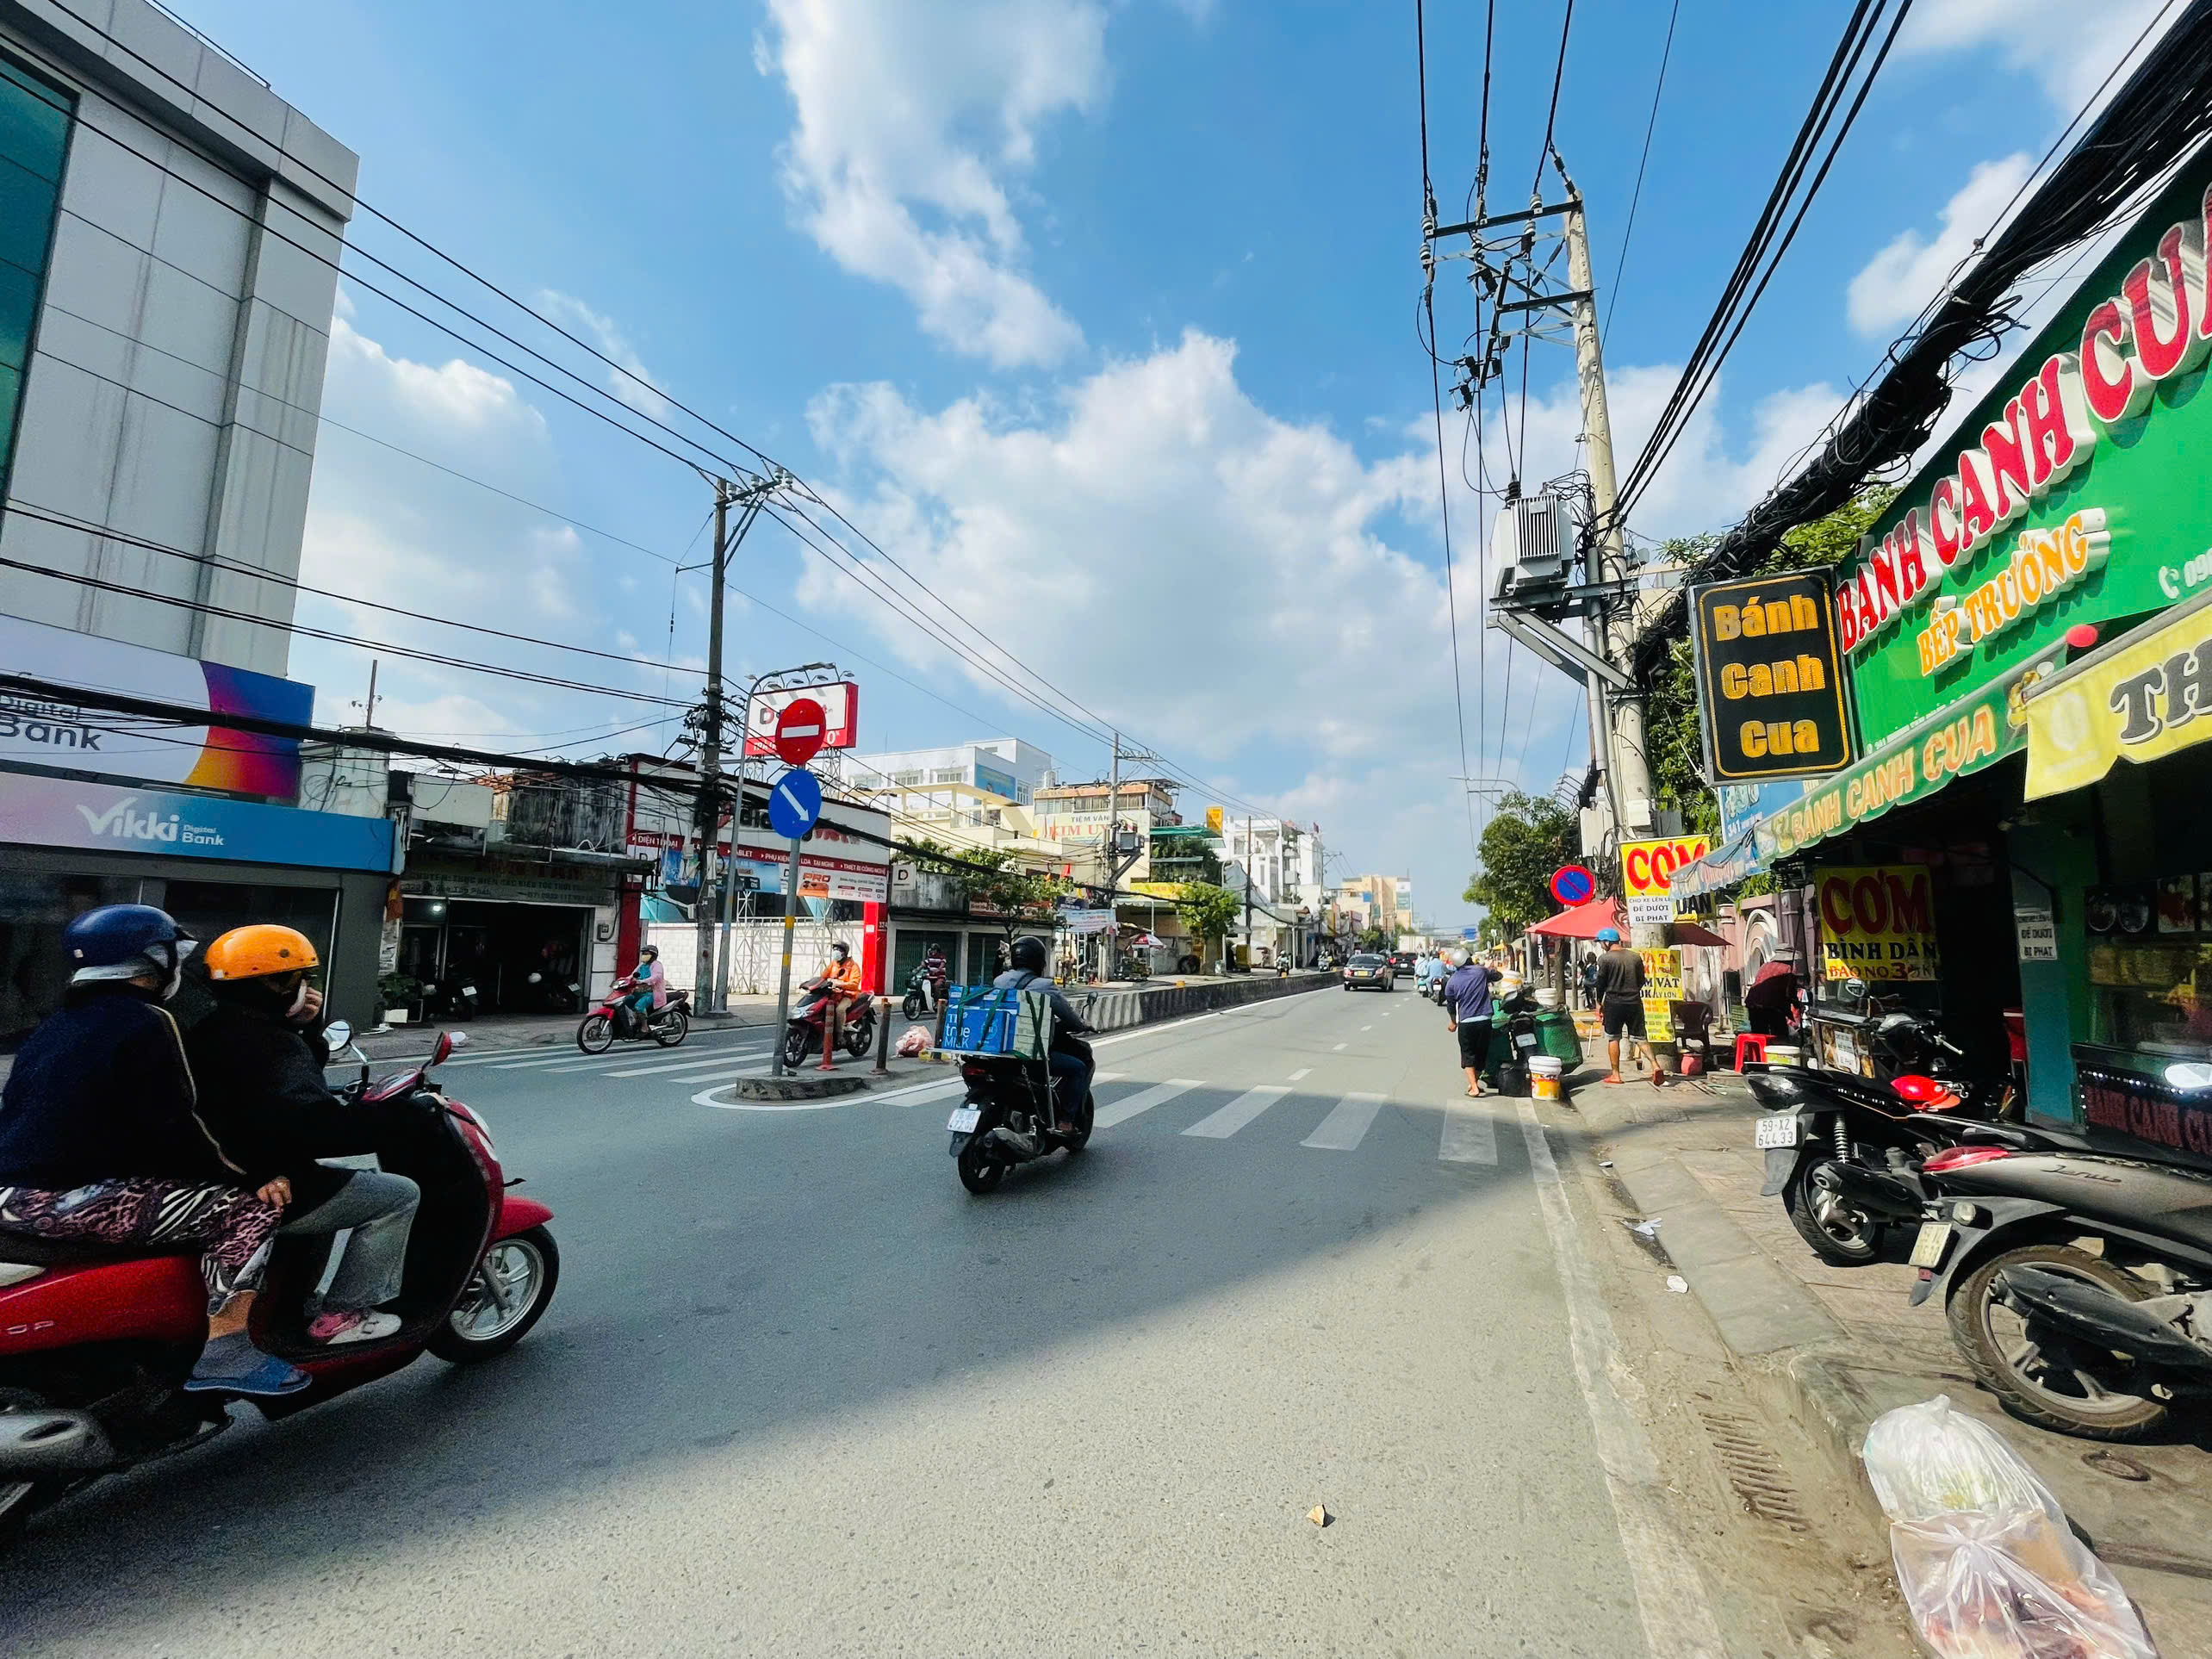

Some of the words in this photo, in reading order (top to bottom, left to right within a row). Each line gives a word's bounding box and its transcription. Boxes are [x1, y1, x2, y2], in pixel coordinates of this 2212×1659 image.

[1836, 508, 1929, 655] BÁNH
[1929, 354, 2077, 569] CANH
[2078, 183, 2212, 424] CU
[1713, 594, 1819, 641] Bánh
[1916, 599, 1960, 677] BẾP
[1721, 654, 1825, 700] Canh
[1740, 719, 1820, 758] Cua
[1791, 787, 1842, 846] BÁNH
[1846, 745, 1915, 820] CANH
[1923, 703, 1997, 782] CUA
[76, 797, 180, 842] Vikki
[182, 832, 225, 846] Bank
[183, 823, 217, 834] Digital
[802, 873, 831, 884] PRO
[1821, 869, 1930, 935] CƠM
[1825, 937, 1882, 960] BÌNH
[1888, 936, 1937, 960] DÂN
[1757, 1131, 1794, 1146] 644.33
[1762, 1118, 1790, 1132] 59-X2
